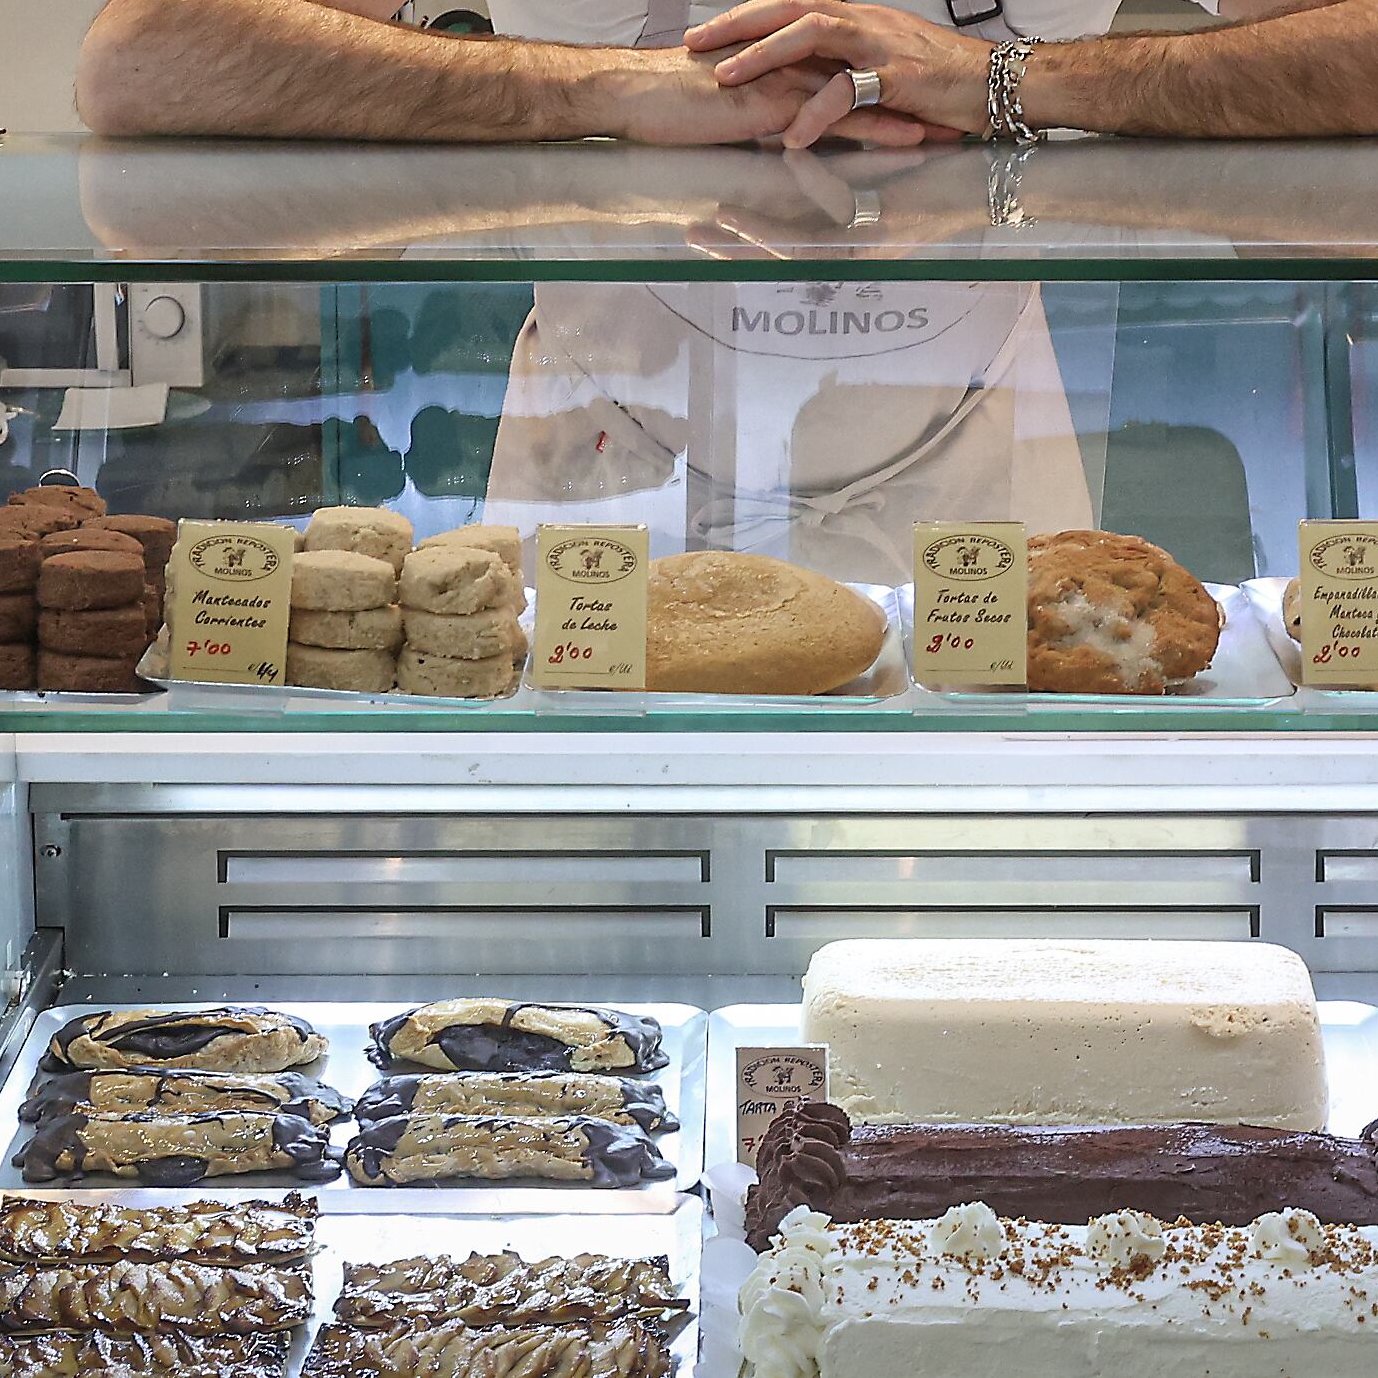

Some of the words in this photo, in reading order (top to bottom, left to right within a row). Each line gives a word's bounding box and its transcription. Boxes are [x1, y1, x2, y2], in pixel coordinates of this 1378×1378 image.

[732, 306, 929, 335] MOLINOS
[214, 568, 252, 576] MOLINOS
[572, 570, 610, 578] MOLINOS
[950, 567, 988, 575] MOLINOS
[192, 590, 271, 609] Mantecados
[936, 589, 979, 603] Tortas
[983, 591, 998, 603] de
[570, 597, 612, 612] Tortas
[1330, 604, 1373, 619] Manteca
[195, 611, 266, 628] Corrientes
[927, 609, 970, 623] Frutos
[975, 609, 1011, 623] Secos
[562, 619, 577, 630] de
[580, 617, 618, 631] Leche
[739, 1099, 777, 1115] TARTA
